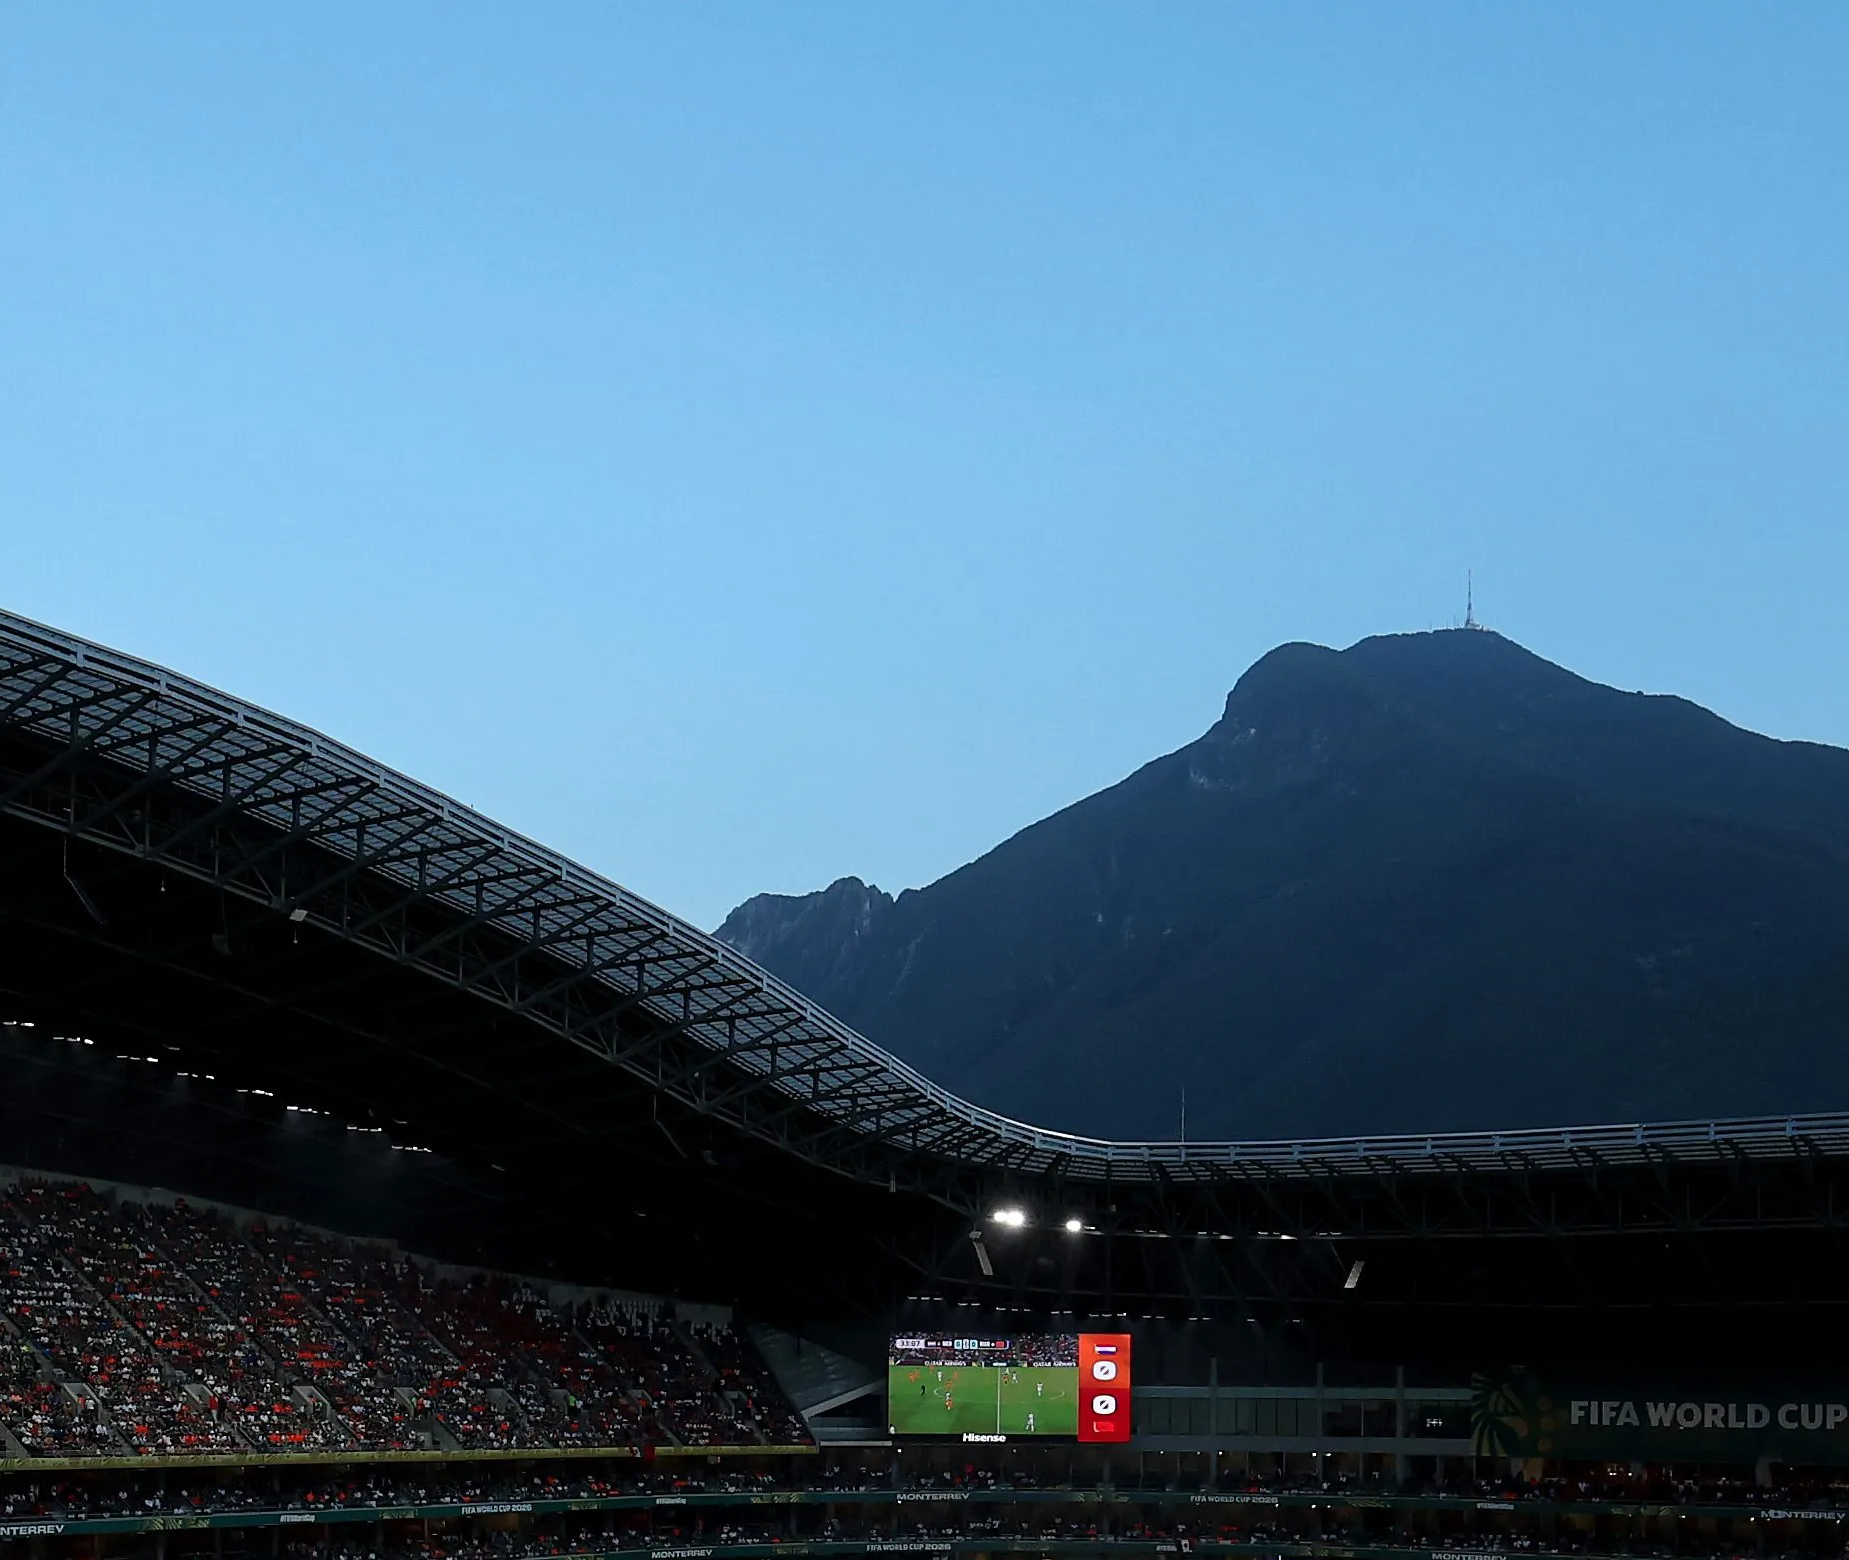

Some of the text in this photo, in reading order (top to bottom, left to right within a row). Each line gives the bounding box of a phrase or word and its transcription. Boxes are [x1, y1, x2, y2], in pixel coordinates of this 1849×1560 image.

[1570, 1400, 1640, 1427] FIFA
[1646, 1402, 1769, 1429] WORLD
[1778, 1403, 1849, 1430] CUP
[963, 1433, 1006, 1443] Hisense
[897, 1493, 970, 1501] MONTERREY
[1761, 1510, 1846, 1520] MONTERREY
[652, 1549, 712, 1559] MONTERREY
